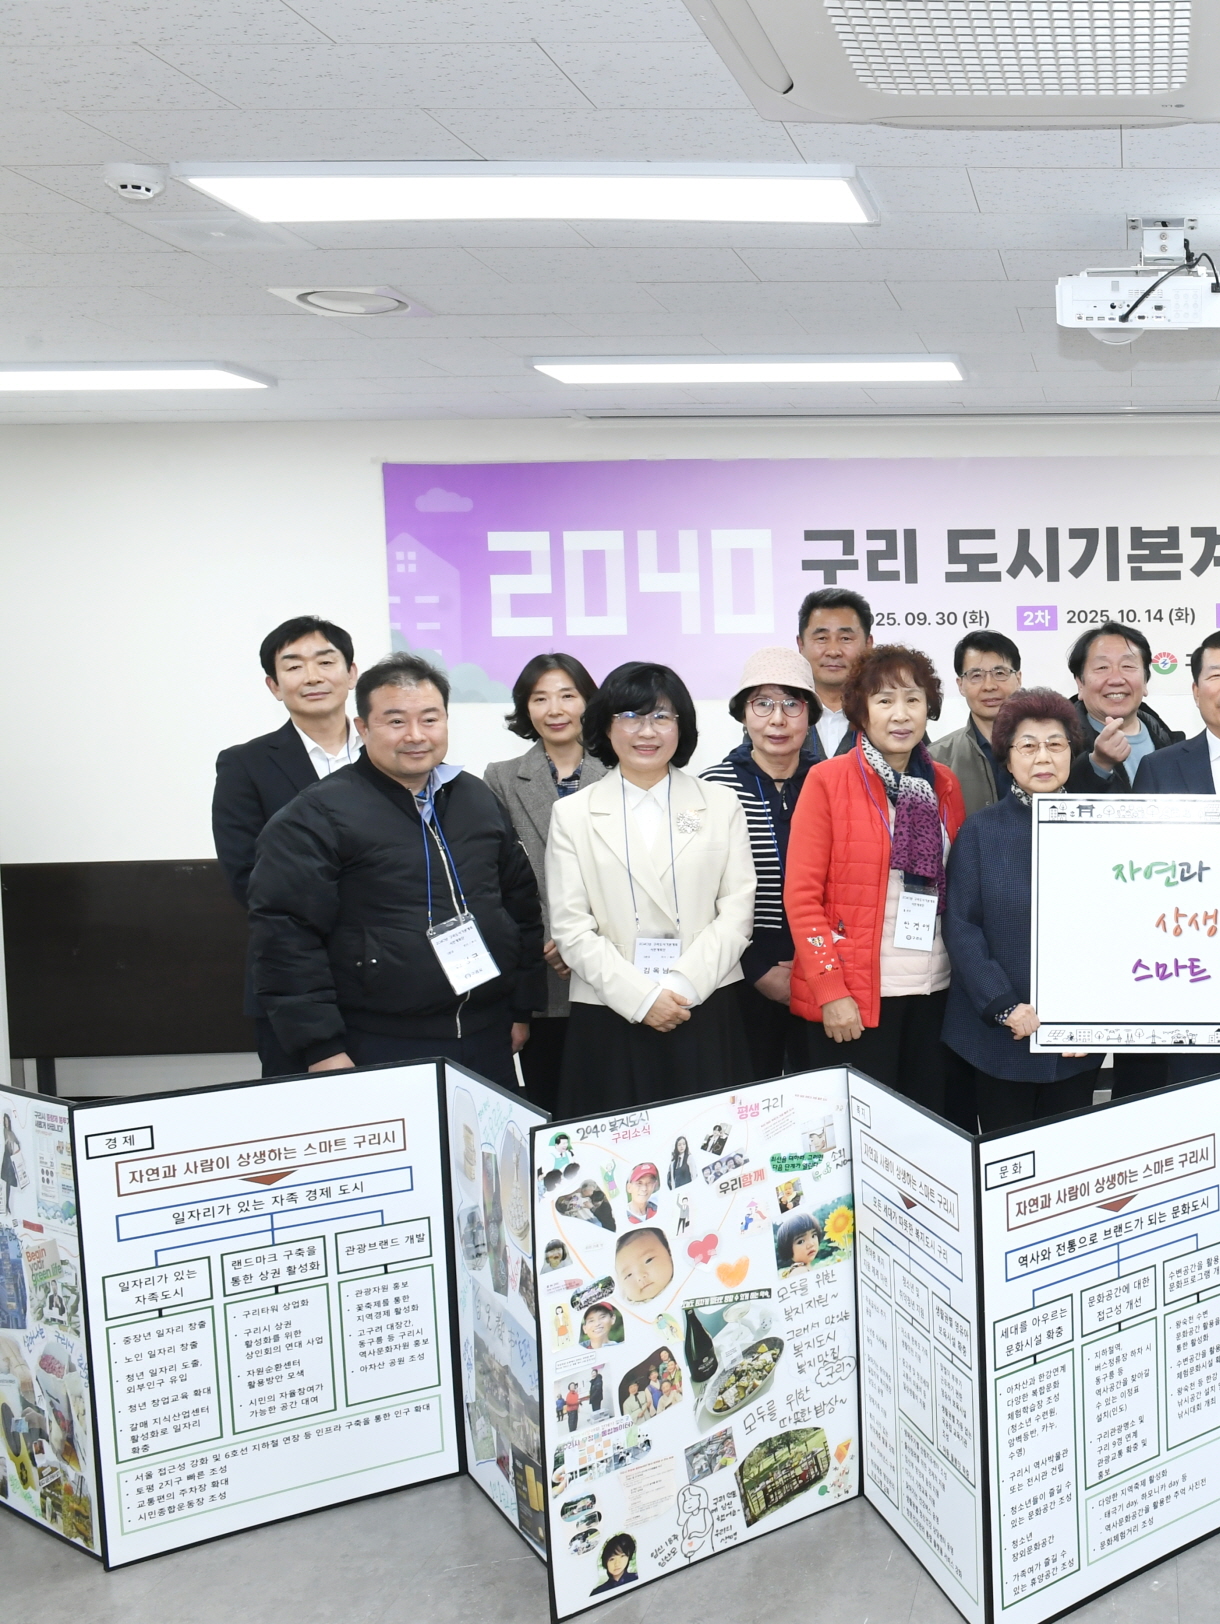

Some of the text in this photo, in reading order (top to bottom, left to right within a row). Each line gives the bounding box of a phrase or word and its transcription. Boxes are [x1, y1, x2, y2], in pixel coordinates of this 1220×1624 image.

[488, 529, 774, 637] 2040
[801, 528, 918, 584] 구리
[870, 612, 901, 626] 25.
[905, 612, 931, 625] 09.
[935, 611, 958, 625] 30
[963, 610, 990, 628] (화)
[1023, 610, 1051, 626] 2차
[1118, 609, 1141, 623] 10.
[1145, 609, 1164, 622] 14
[1168, 607, 1195, 626] (화)
[1112, 860, 1210, 887] 자연과
[1132, 958, 1211, 983] 스마트
[737, 1105, 760, 1120] 평생
[762, 1094, 783, 1113] 구리
[129, 1131, 396, 1184] 자연과 사람이 상생하는 스마트 구리시
[719, 1169, 766, 1194] 우리함께
[864, 1143, 954, 1218] 자연과 사람이 상생하는 스마트 구리시
[1016, 1147, 1209, 1217] 자연과 사람이 상생하는 스마트 구리시
[172, 1181, 364, 1225] 일자리가 있는 자족 경제 도시
[344, 1232, 426, 1256] 관광브랜드 개발
[1018, 1197, 1209, 1269] 역사와 전통으로 브랜드가 되는 문화도시
[26, 1247, 46, 1262] Begin
[29, 1260, 44, 1273] your
[231, 1246, 317, 1270] 랜드마크 구축을
[118, 1268, 197, 1292] 일자리가 있는
[231, 1261, 320, 1287] 통한 상권 활성화
[1169, 1262, 1203, 1279] 수변공간을
[1169, 1271, 1211, 1292] 문화프로그램
[135, 1288, 184, 1306] 자족도시
[778, 1279, 809, 1302] 모두를
[816, 1270, 836, 1287] 위한
[1088, 1276, 1150, 1307] 문화공간에 대한
[242, 1298, 309, 1319] 구리타워 상업화
[1097, 1297, 1142, 1322] 접근성 개선
[1000, 1308, 1067, 1340] 세대를 아우르는
[124, 1341, 198, 1364] 노인 일자리 창출
[1006, 1326, 1063, 1356] 문화시설 확충
[744, 1386, 810, 1435] 모두를 위한
